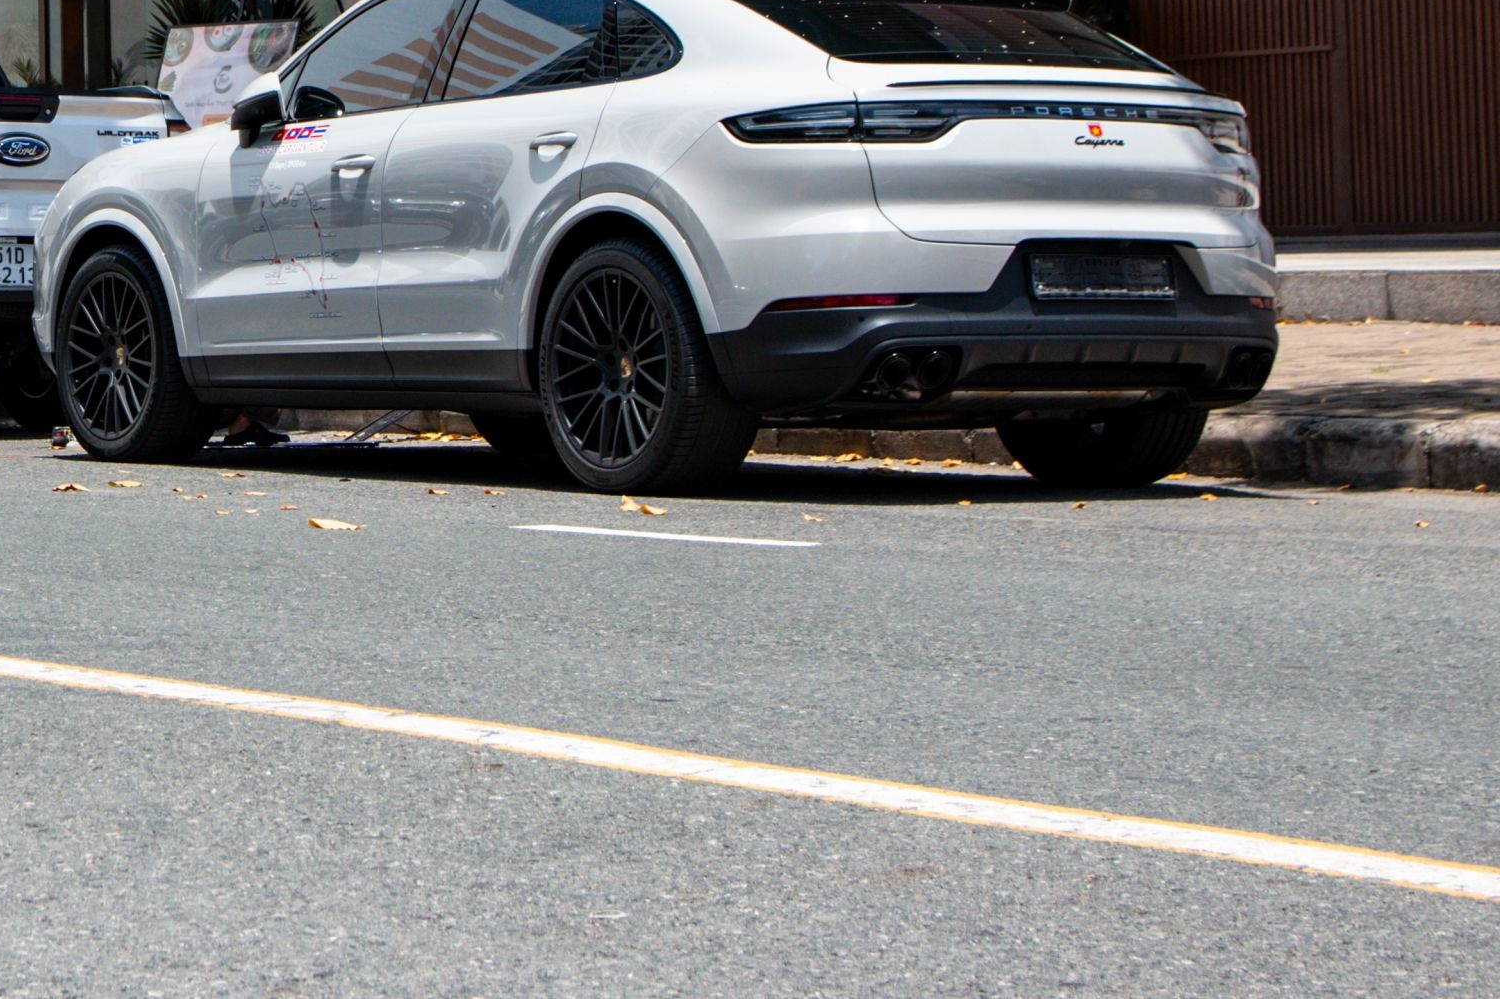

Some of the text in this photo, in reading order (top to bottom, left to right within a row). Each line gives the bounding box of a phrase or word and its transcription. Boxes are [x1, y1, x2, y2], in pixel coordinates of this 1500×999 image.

[1010, 105, 1159, 119] PORSCHE
[97, 129, 160, 137] WILDTRAK
[8, 141, 38, 156] Ford
[1074, 135, 1126, 149] Cayenne
